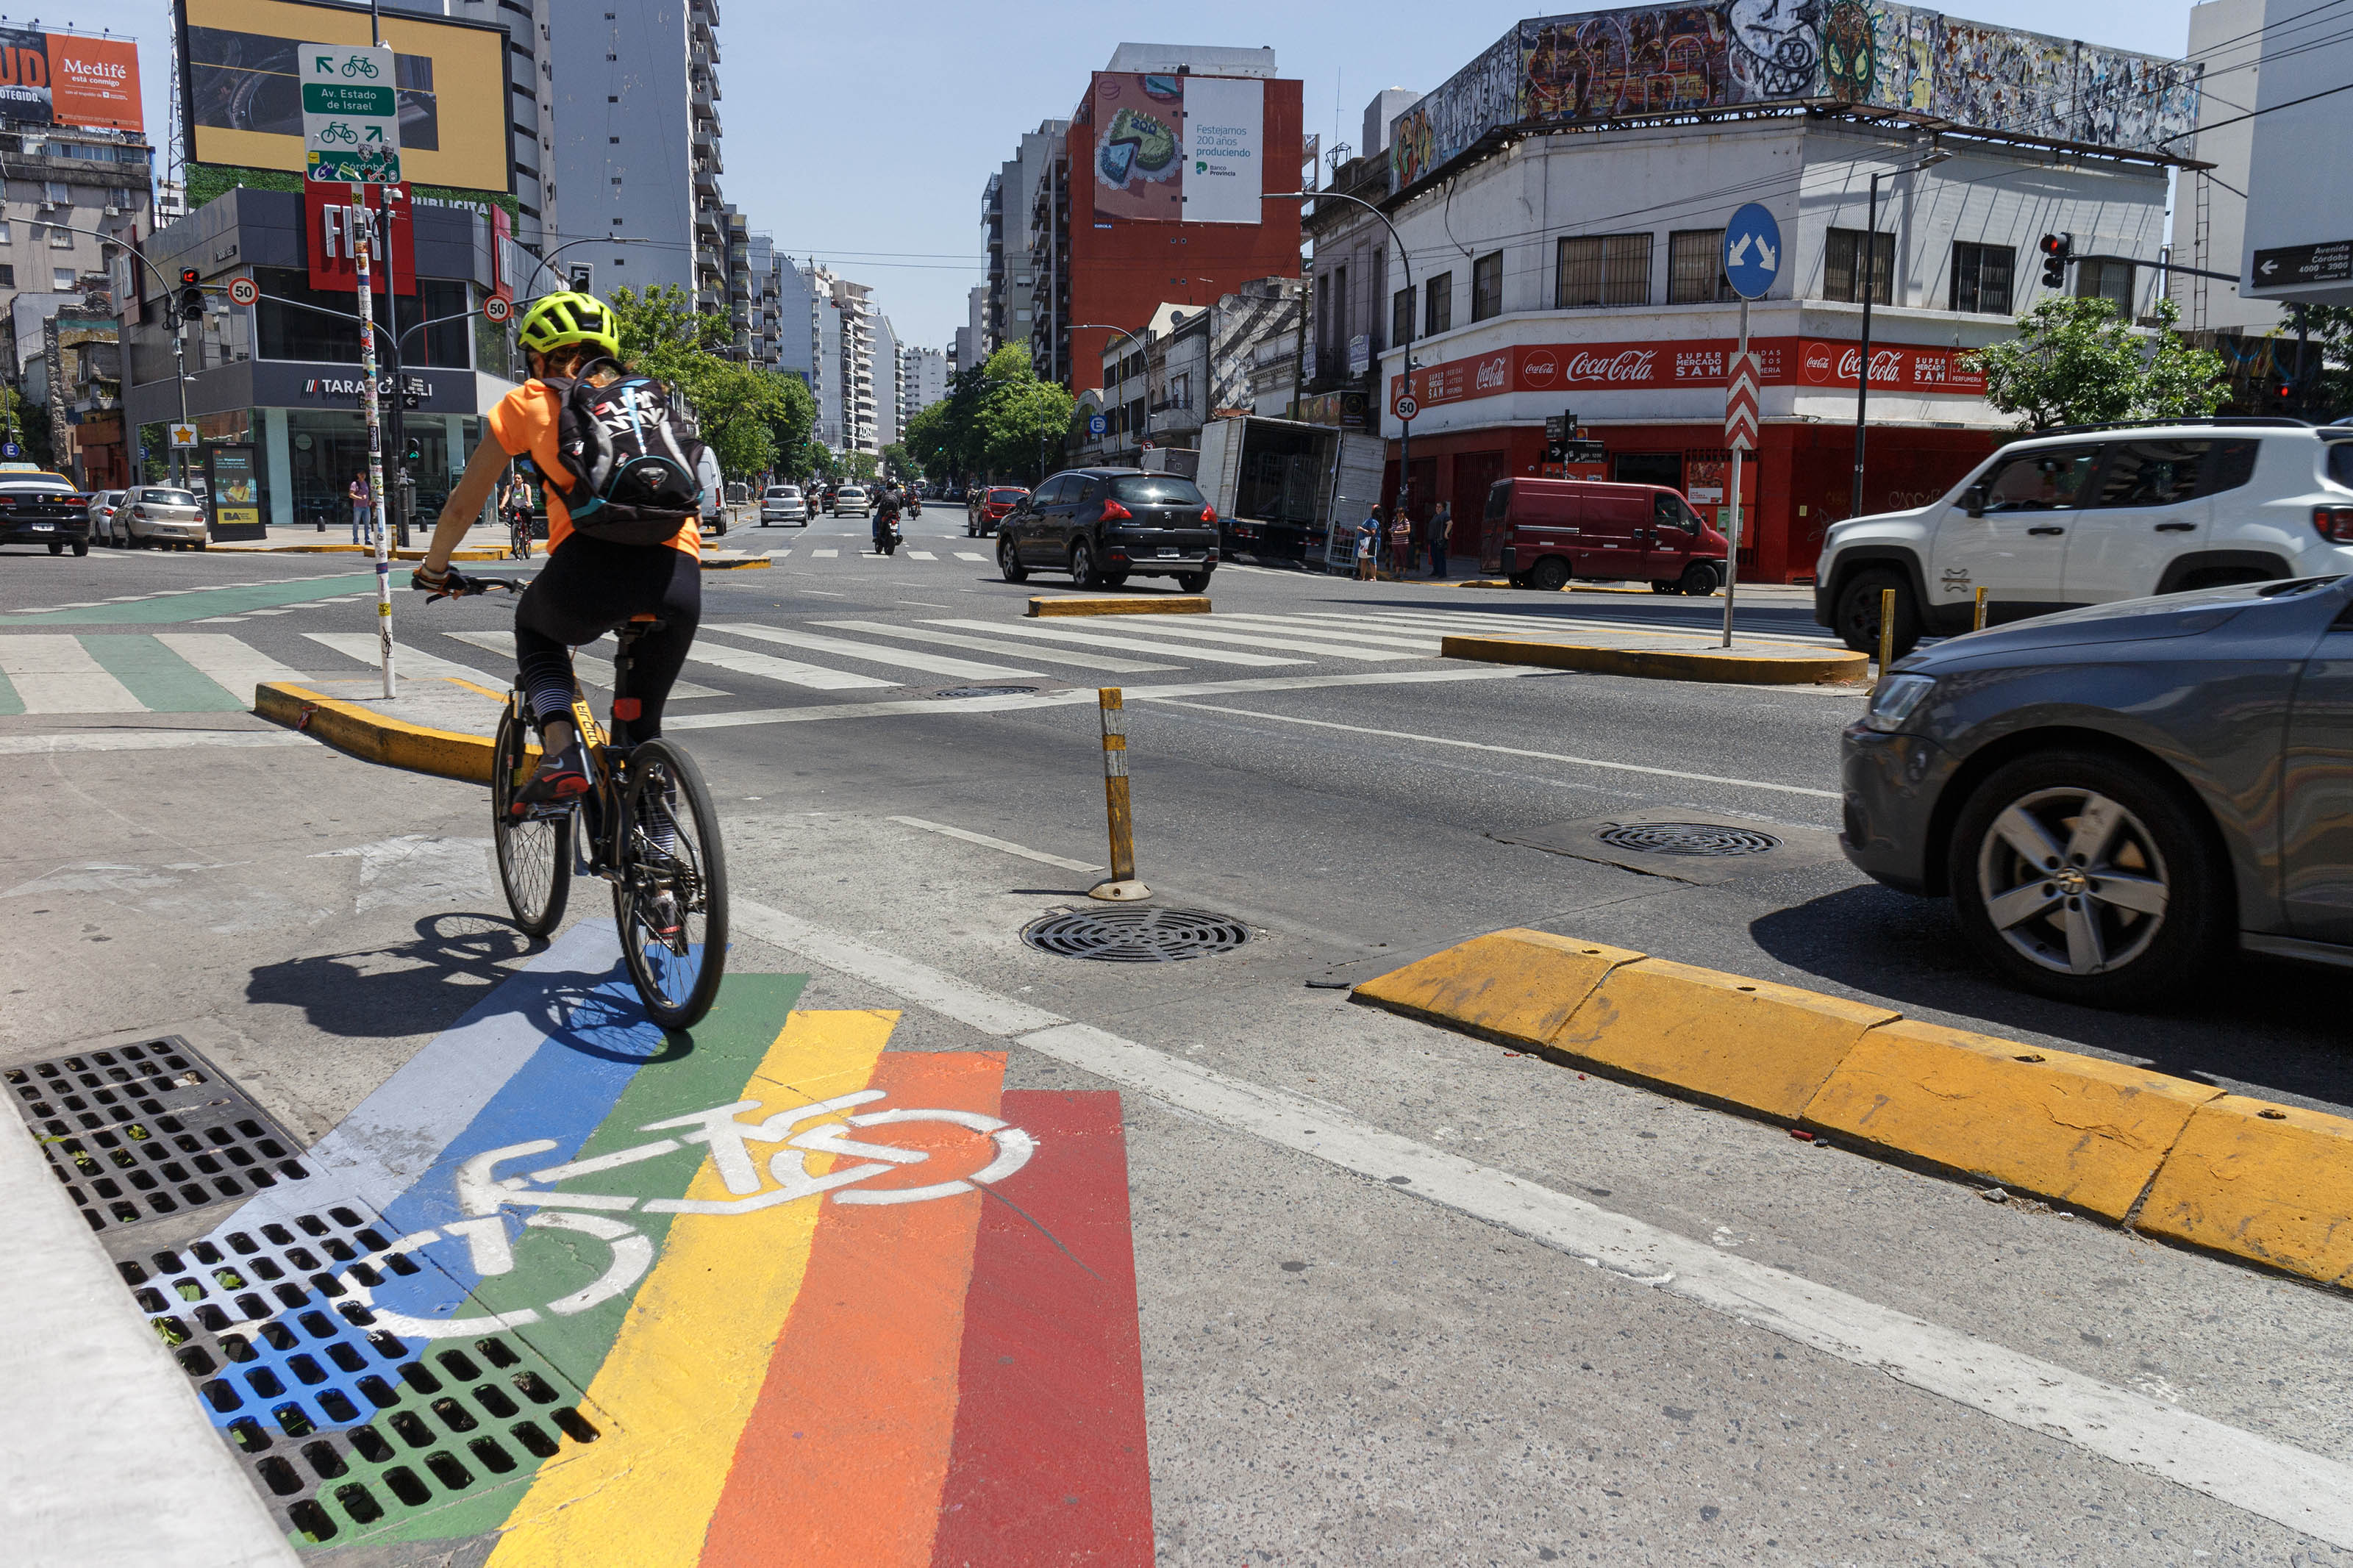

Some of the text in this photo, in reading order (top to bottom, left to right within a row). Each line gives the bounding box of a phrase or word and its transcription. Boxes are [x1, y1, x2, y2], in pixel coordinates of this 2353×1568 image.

[64, 59, 126, 79] Medifé
[90, 77, 120, 87] conmigo
[321, 89, 376, 100] Av. Estado
[327, 101, 373, 110] de Israel
[1131, 118, 1157, 136] 200
[1196, 125, 1246, 136] Festejamos
[1196, 137, 1238, 146] 200 años
[1196, 148, 1251, 157] produciendo
[2314, 244, 2349, 254] Avenida
[2312, 254, 2349, 263] Córdoba
[2299, 265, 2319, 273] 4000
[2327, 262, 2348, 271] 3900
[235, 286, 252, 298] 50
[490, 303, 505, 315] 50
[1429, 371, 1444, 382] SUPER
[1676, 366, 1721, 376] SAM
[1914, 370, 1945, 382] SAM
[1429, 379, 1443, 388] MERCADO
[1428, 387, 1443, 399] SAM
[1399, 402, 1414, 413] 50
[1093, 420, 1103, 429] E
[859, 426, 872, 438] ADN
[7, 445, 15, 455] E
